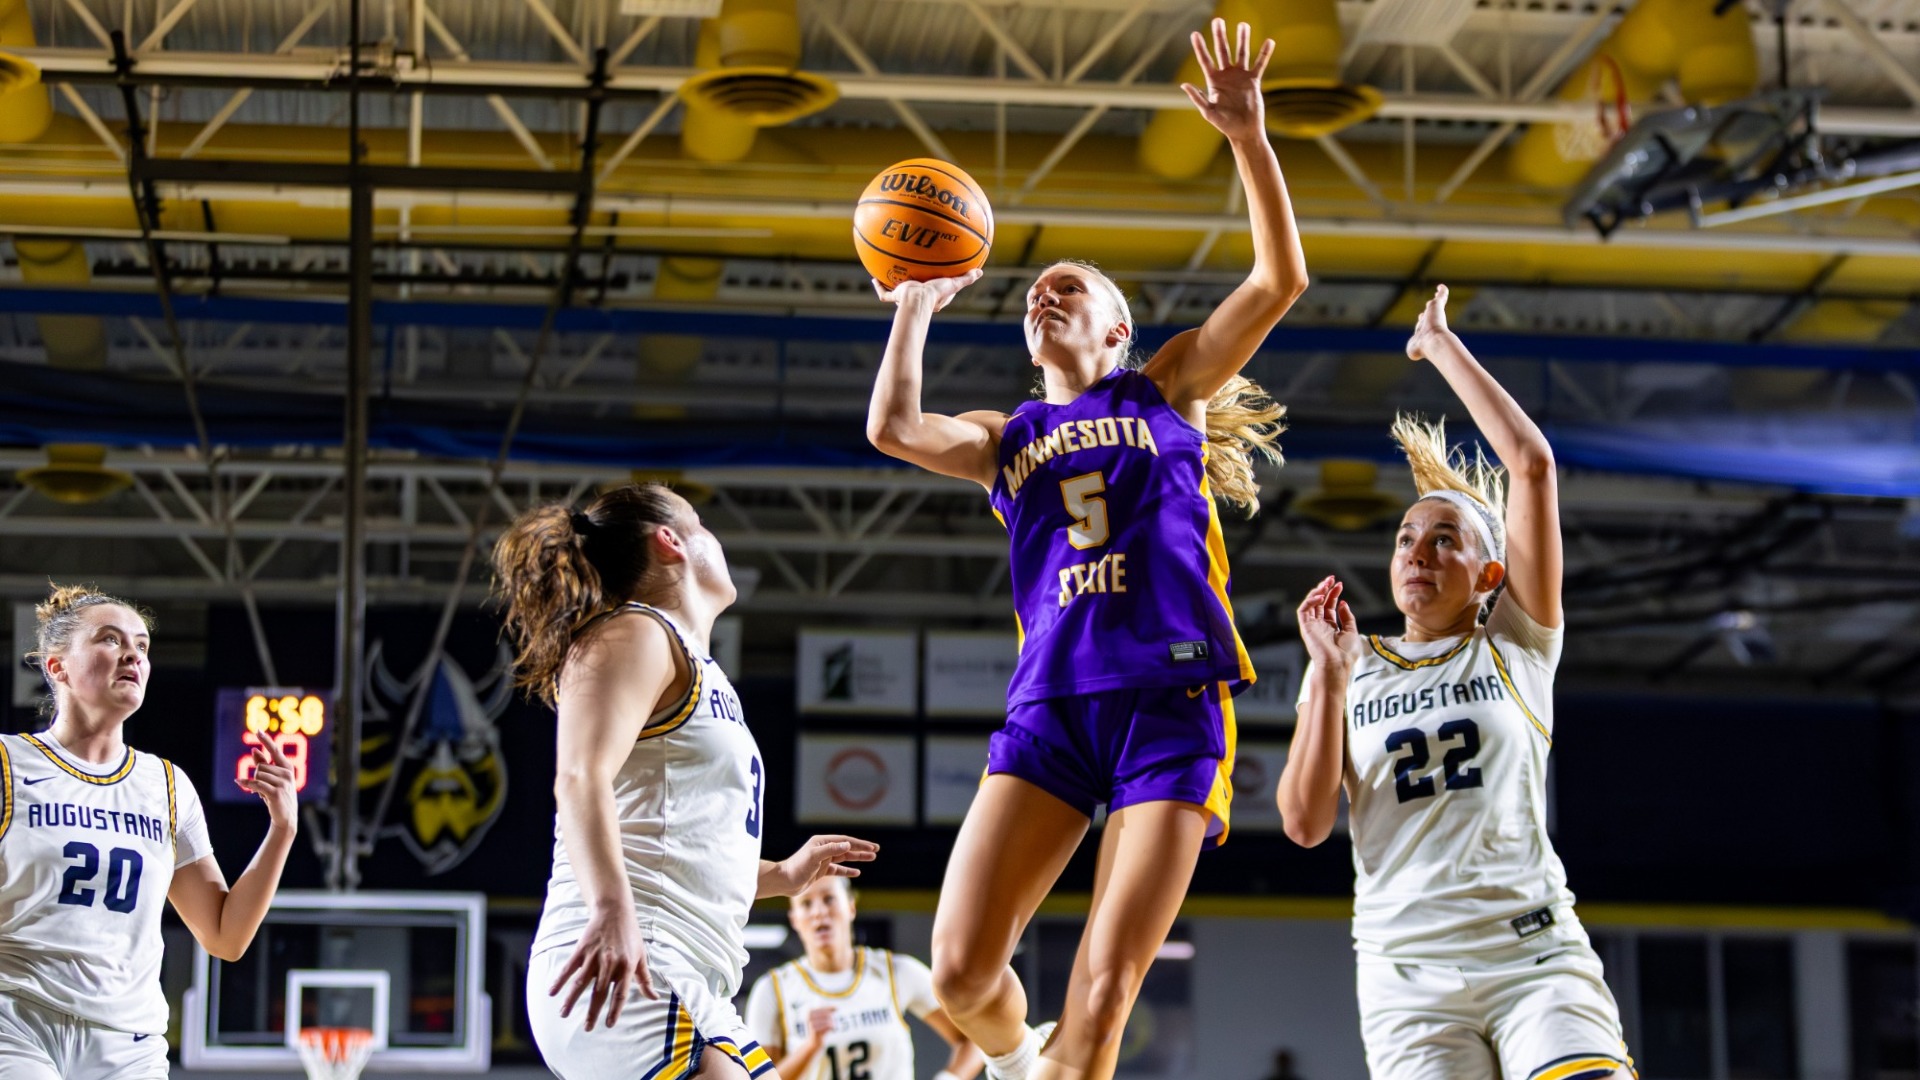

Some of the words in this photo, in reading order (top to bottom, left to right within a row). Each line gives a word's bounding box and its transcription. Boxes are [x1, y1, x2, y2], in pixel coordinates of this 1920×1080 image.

[880, 173, 970, 219] Wilson
[1002, 417, 1159, 501] MINNESOTA
[1059, 470, 1110, 550] 5
[1058, 553, 1127, 608] STATE
[1353, 675, 1504, 730] AUGUSTANA
[1384, 717, 1484, 805] 22
[28, 803, 164, 844] AUGUSTANA
[745, 754, 761, 839] 3
[57, 841, 144, 914] 20
[826, 1040, 872, 1080] 12
